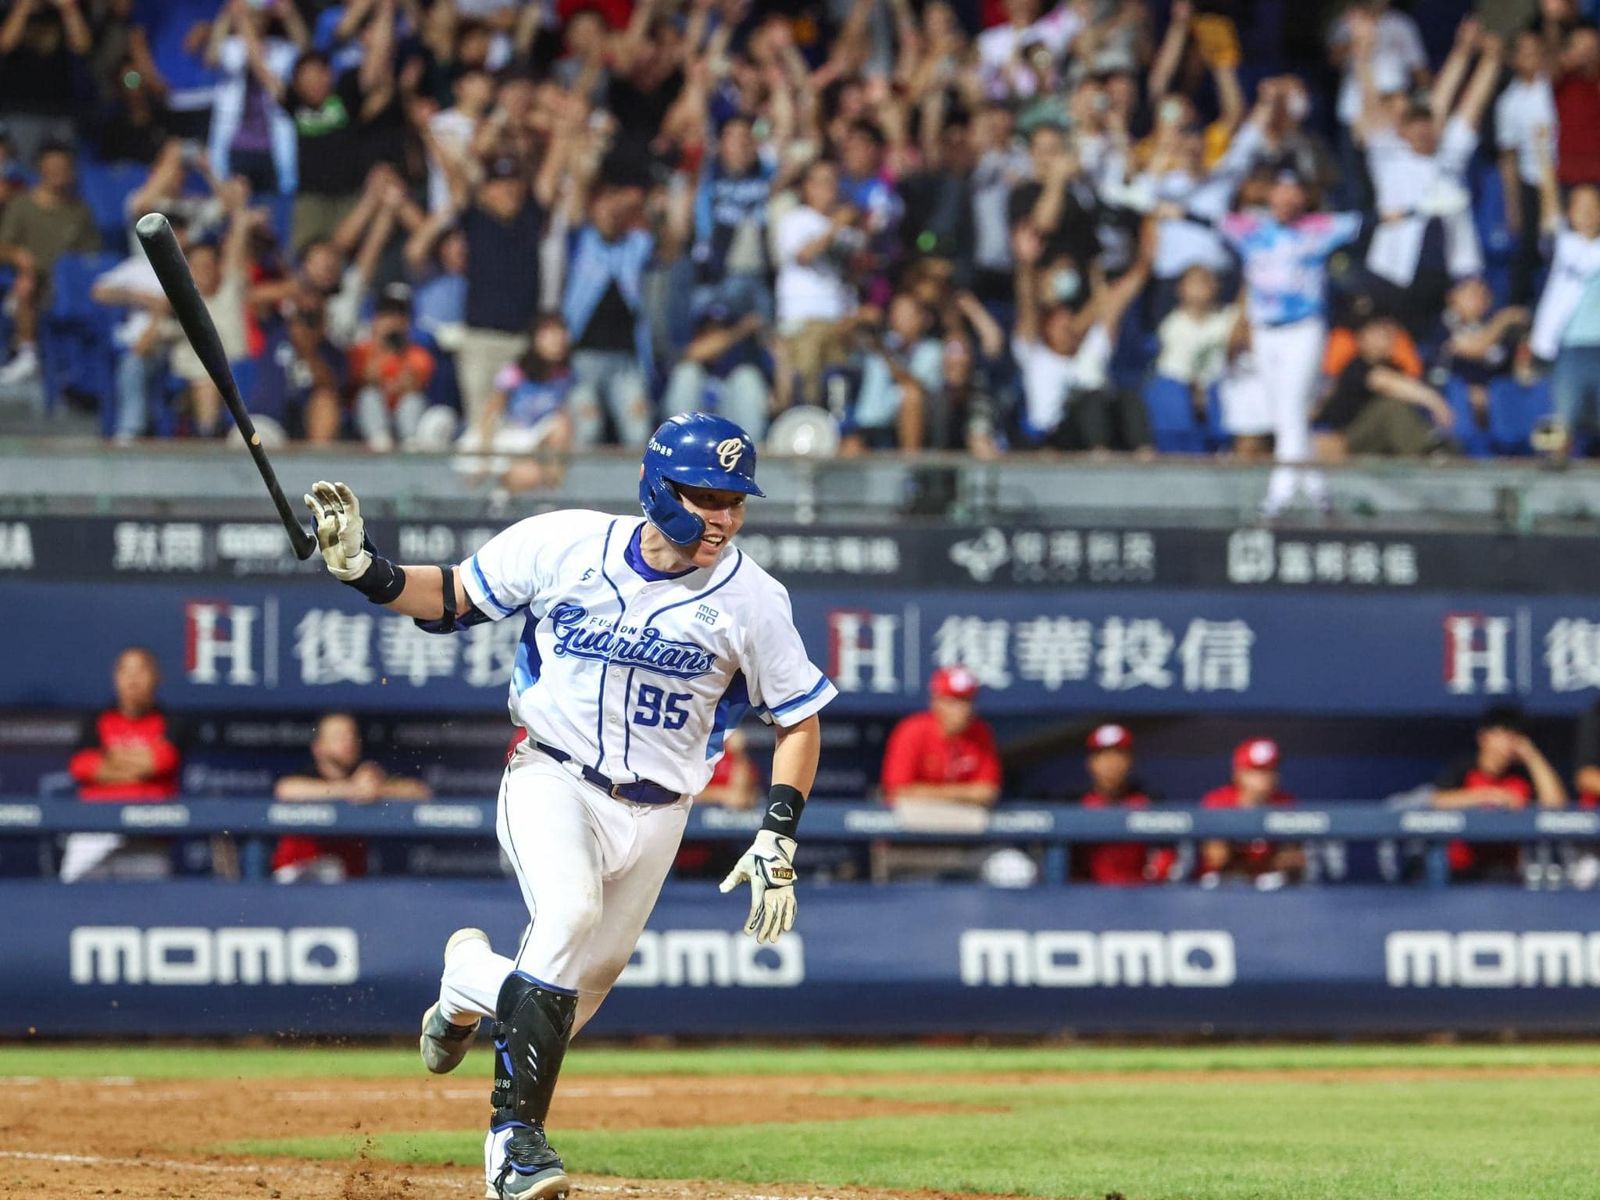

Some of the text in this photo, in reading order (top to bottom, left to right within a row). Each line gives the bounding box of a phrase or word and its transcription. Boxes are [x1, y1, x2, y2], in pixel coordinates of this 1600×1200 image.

[549, 602, 719, 680] Guardians
[934, 616, 1253, 692] 復華投信
[633, 683, 693, 730] 95
[1385, 930, 1600, 988] mom
